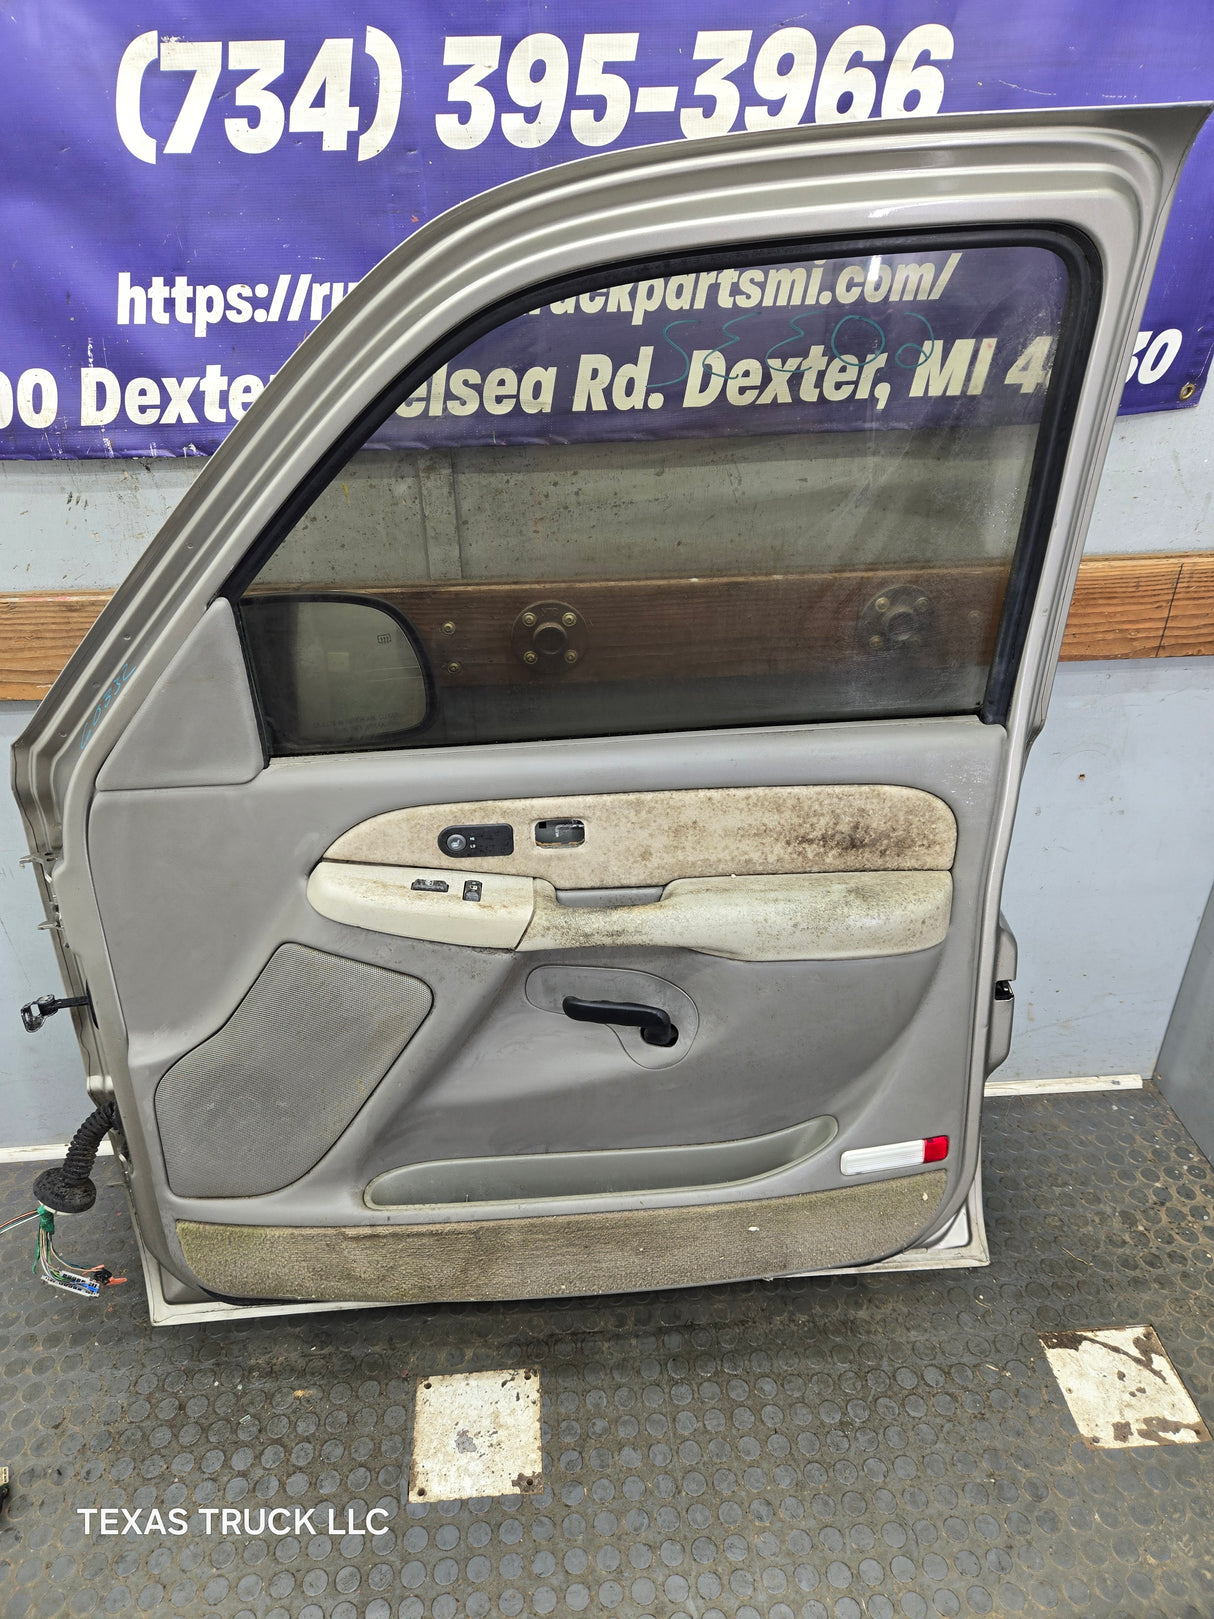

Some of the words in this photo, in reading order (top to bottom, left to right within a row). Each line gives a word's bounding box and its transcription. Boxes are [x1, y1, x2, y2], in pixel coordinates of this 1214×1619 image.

[115, 25, 403, 165] (734)
[434, 23, 955, 150] 395-3966
[80, 364, 280, 427] Dexte
[571, 345, 665, 412] Rd.
[682, 344, 890, 410] Dexter,
[908, 337, 998, 398] MI
